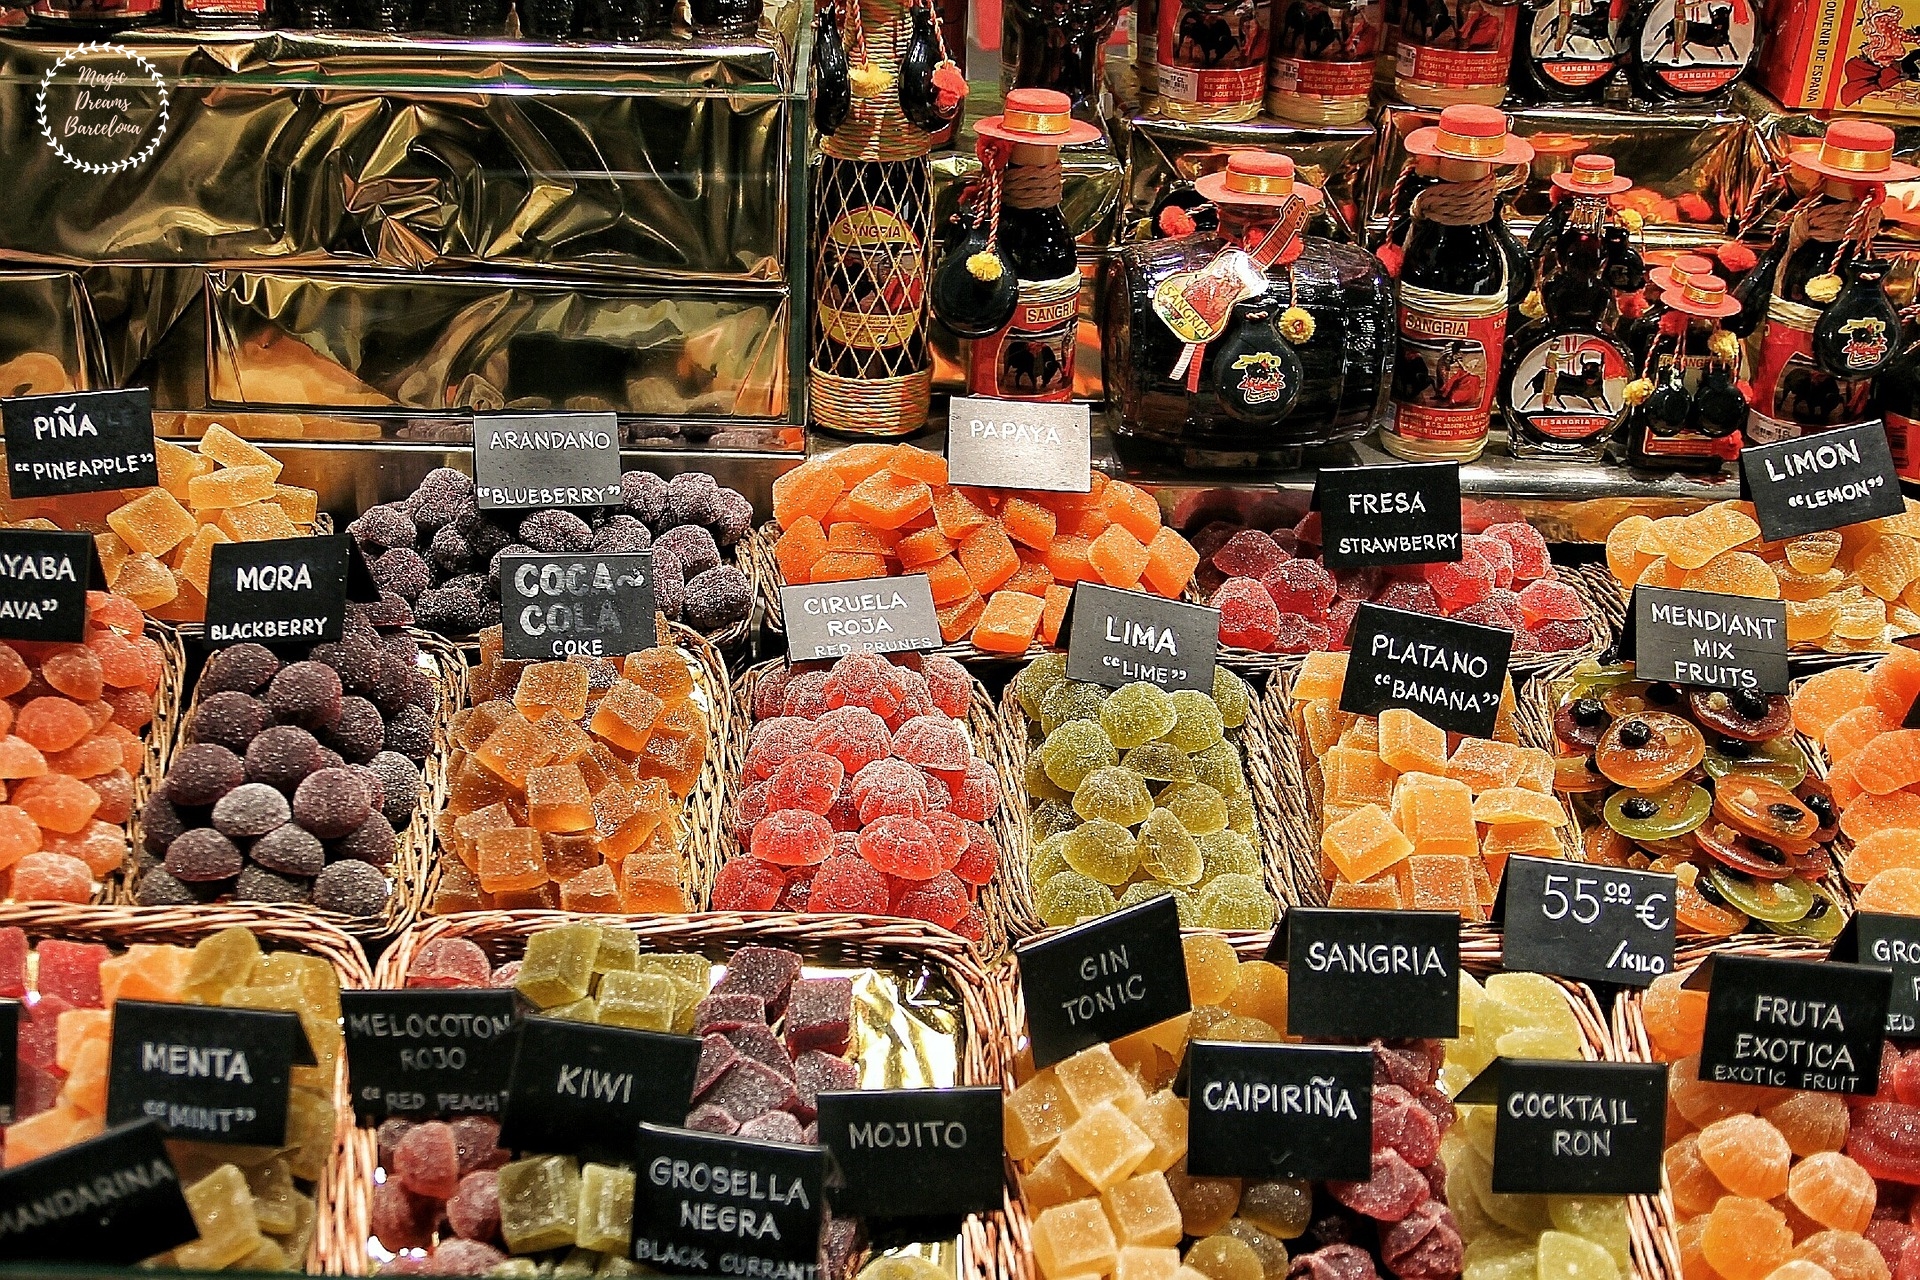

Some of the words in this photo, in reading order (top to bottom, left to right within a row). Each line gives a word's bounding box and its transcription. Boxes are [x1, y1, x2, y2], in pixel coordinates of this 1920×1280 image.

[1819, 0, 1837, 46] OUVENIR
[1815, 49, 1827, 62] DE
[1806, 65, 1823, 102] ESPAÑA
[1162, 285, 1210, 338] SANGRIA
[1406, 314, 1467, 336] SANGRIA
[33, 402, 98, 440] PIÑA
[970, 419, 1062, 446] PAPAYA
[489, 430, 611, 451] ARANDANO
[14, 453, 154, 481] “PINEAPPLE”
[1764, 437, 1862, 483] LIMON
[477, 484, 620, 505] “BLUEBERRY”
[1348, 491, 1427, 515] FRESA
[1788, 474, 1884, 509] “LEMON”
[1338, 533, 1458, 554] STRAWBERRY
[236, 564, 313, 592] MORA
[519, 600, 624, 636] COLA
[803, 591, 908, 615] CIRUELA
[210, 616, 328, 641] BLACKBERRY
[826, 616, 895, 637] ROJA
[1104, 615, 1178, 656] LIMA
[1651, 602, 1777, 640] MENDIANT
[552, 639, 603, 656] COKE
[814, 643, 852, 657] RED
[863, 637, 934, 653] PRUNES
[1371, 633, 1488, 678] PLATANO
[1693, 638, 1736, 660] MIX
[1102, 655, 1188, 684] “LIME”
[1673, 660, 1758, 688] FRUITS
[1374, 673, 1500, 713] “BANANA”
[1635, 893, 1670, 931] €
[1079, 943, 1130, 982] GIN
[1305, 940, 1448, 978] SANGRIA
[1060, 973, 1147, 1026] TONIC
[1754, 995, 1845, 1031] FRUTA
[349, 1012, 511, 1040] MELOCOTON
[1884, 1013, 1915, 1032] ED
[141, 1041, 253, 1084] MENTA
[400, 1046, 467, 1071] ROJO
[1735, 1033, 1855, 1071] EXOTICA
[558, 1063, 634, 1104] KIWI
[1714, 1064, 1786, 1086] EXOTIC
[1802, 1073, 1859, 1092] FRUIT
[1201, 1074, 1358, 1120] CAIPIRIÑA
[1507, 1092, 1638, 1125] COCKTAIL
[143, 1100, 257, 1132] “MINT”
[849, 1120, 968, 1150] MOJITO
[1552, 1129, 1612, 1157] RON
[649, 1155, 810, 1210] GROSELLA
[680, 1199, 782, 1241] NEGRA
[635, 1238, 710, 1270] BLACK
[719, 1252, 819, 1280] CURRANT
